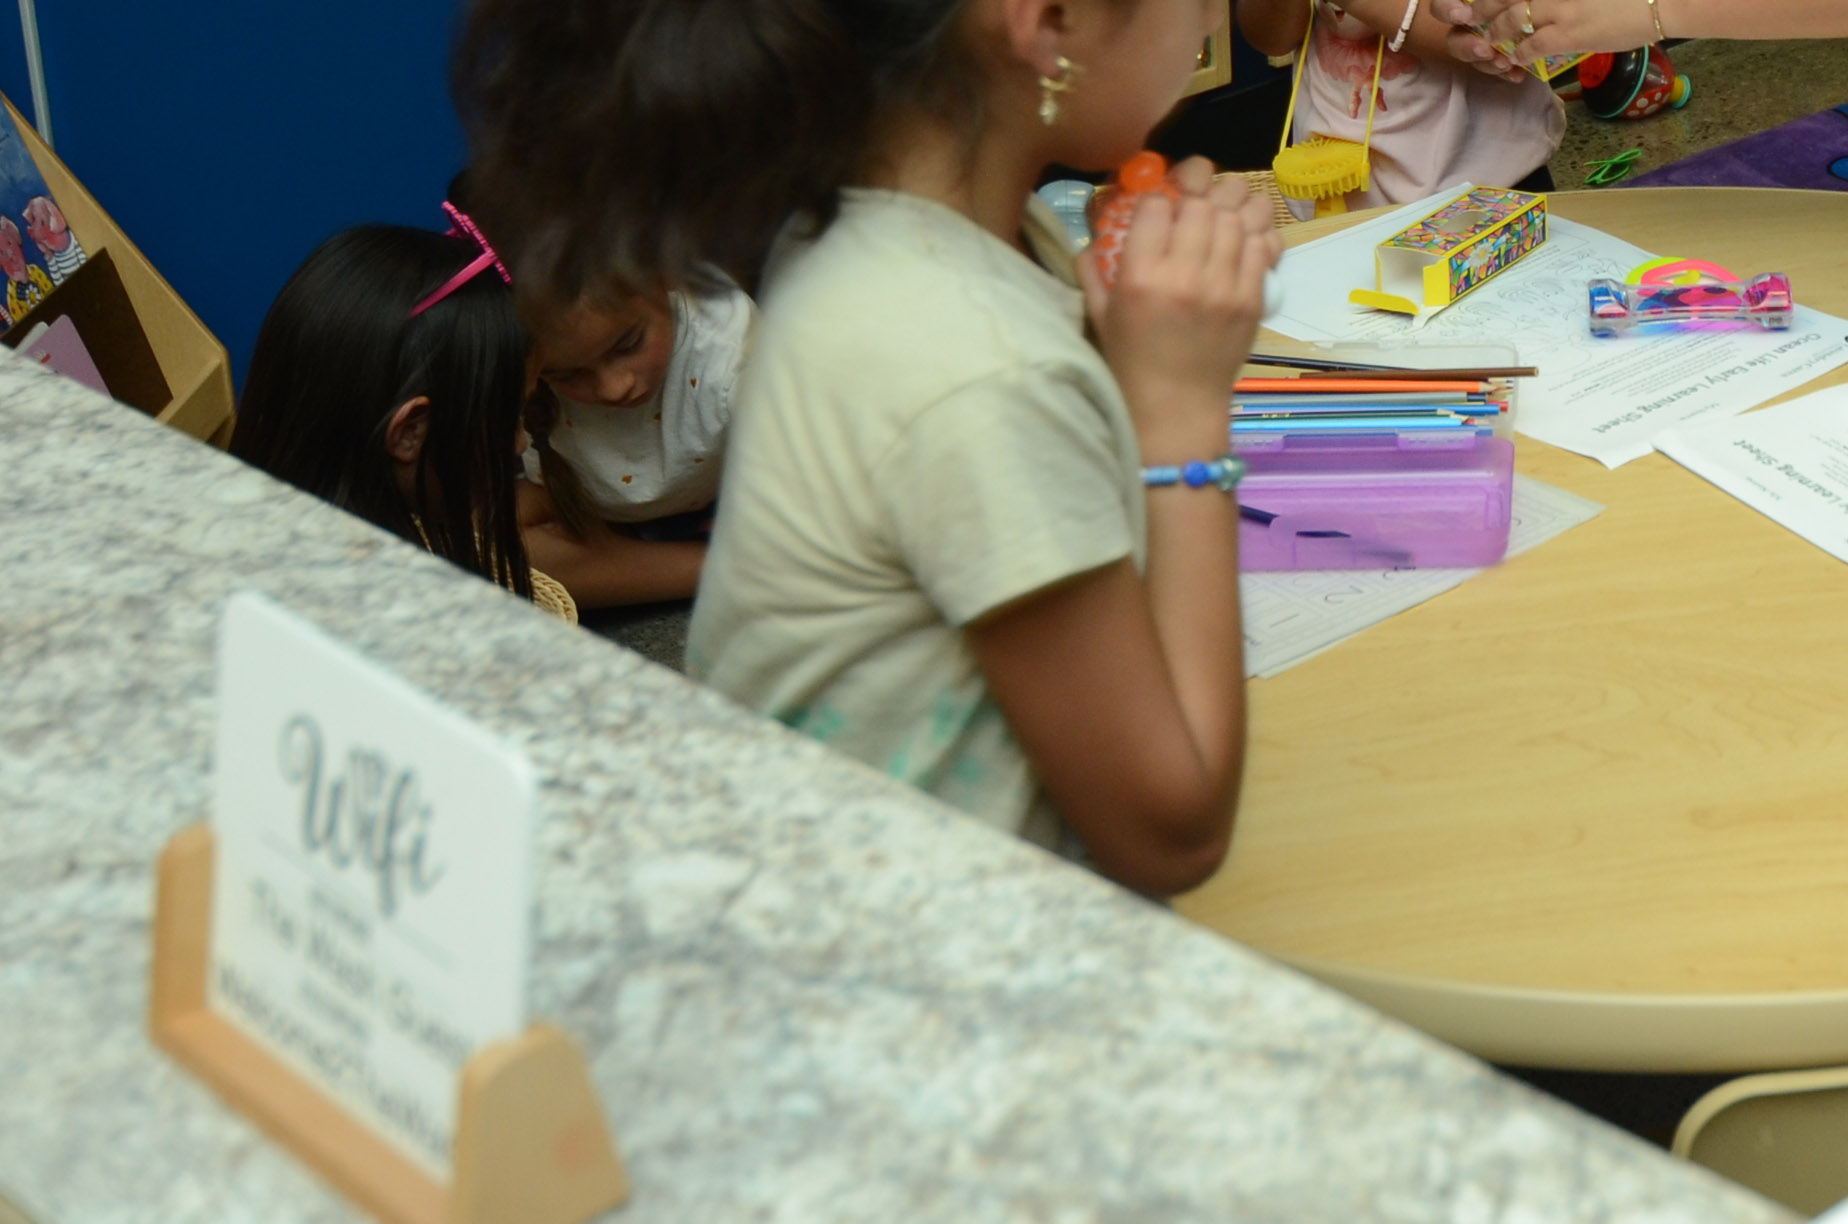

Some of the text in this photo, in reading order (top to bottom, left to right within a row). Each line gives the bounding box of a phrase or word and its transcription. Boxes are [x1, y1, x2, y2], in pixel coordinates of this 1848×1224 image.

[1774, 334, 1821, 353] Ocean
[1746, 354, 1776, 366] Life
[1705, 366, 1749, 384] Early
[1640, 384, 1709, 413] Learning
[1592, 407, 1642, 433] Sheet
[1733, 440, 1778, 465] Sheet
[1777, 464, 1840, 502] Learning
